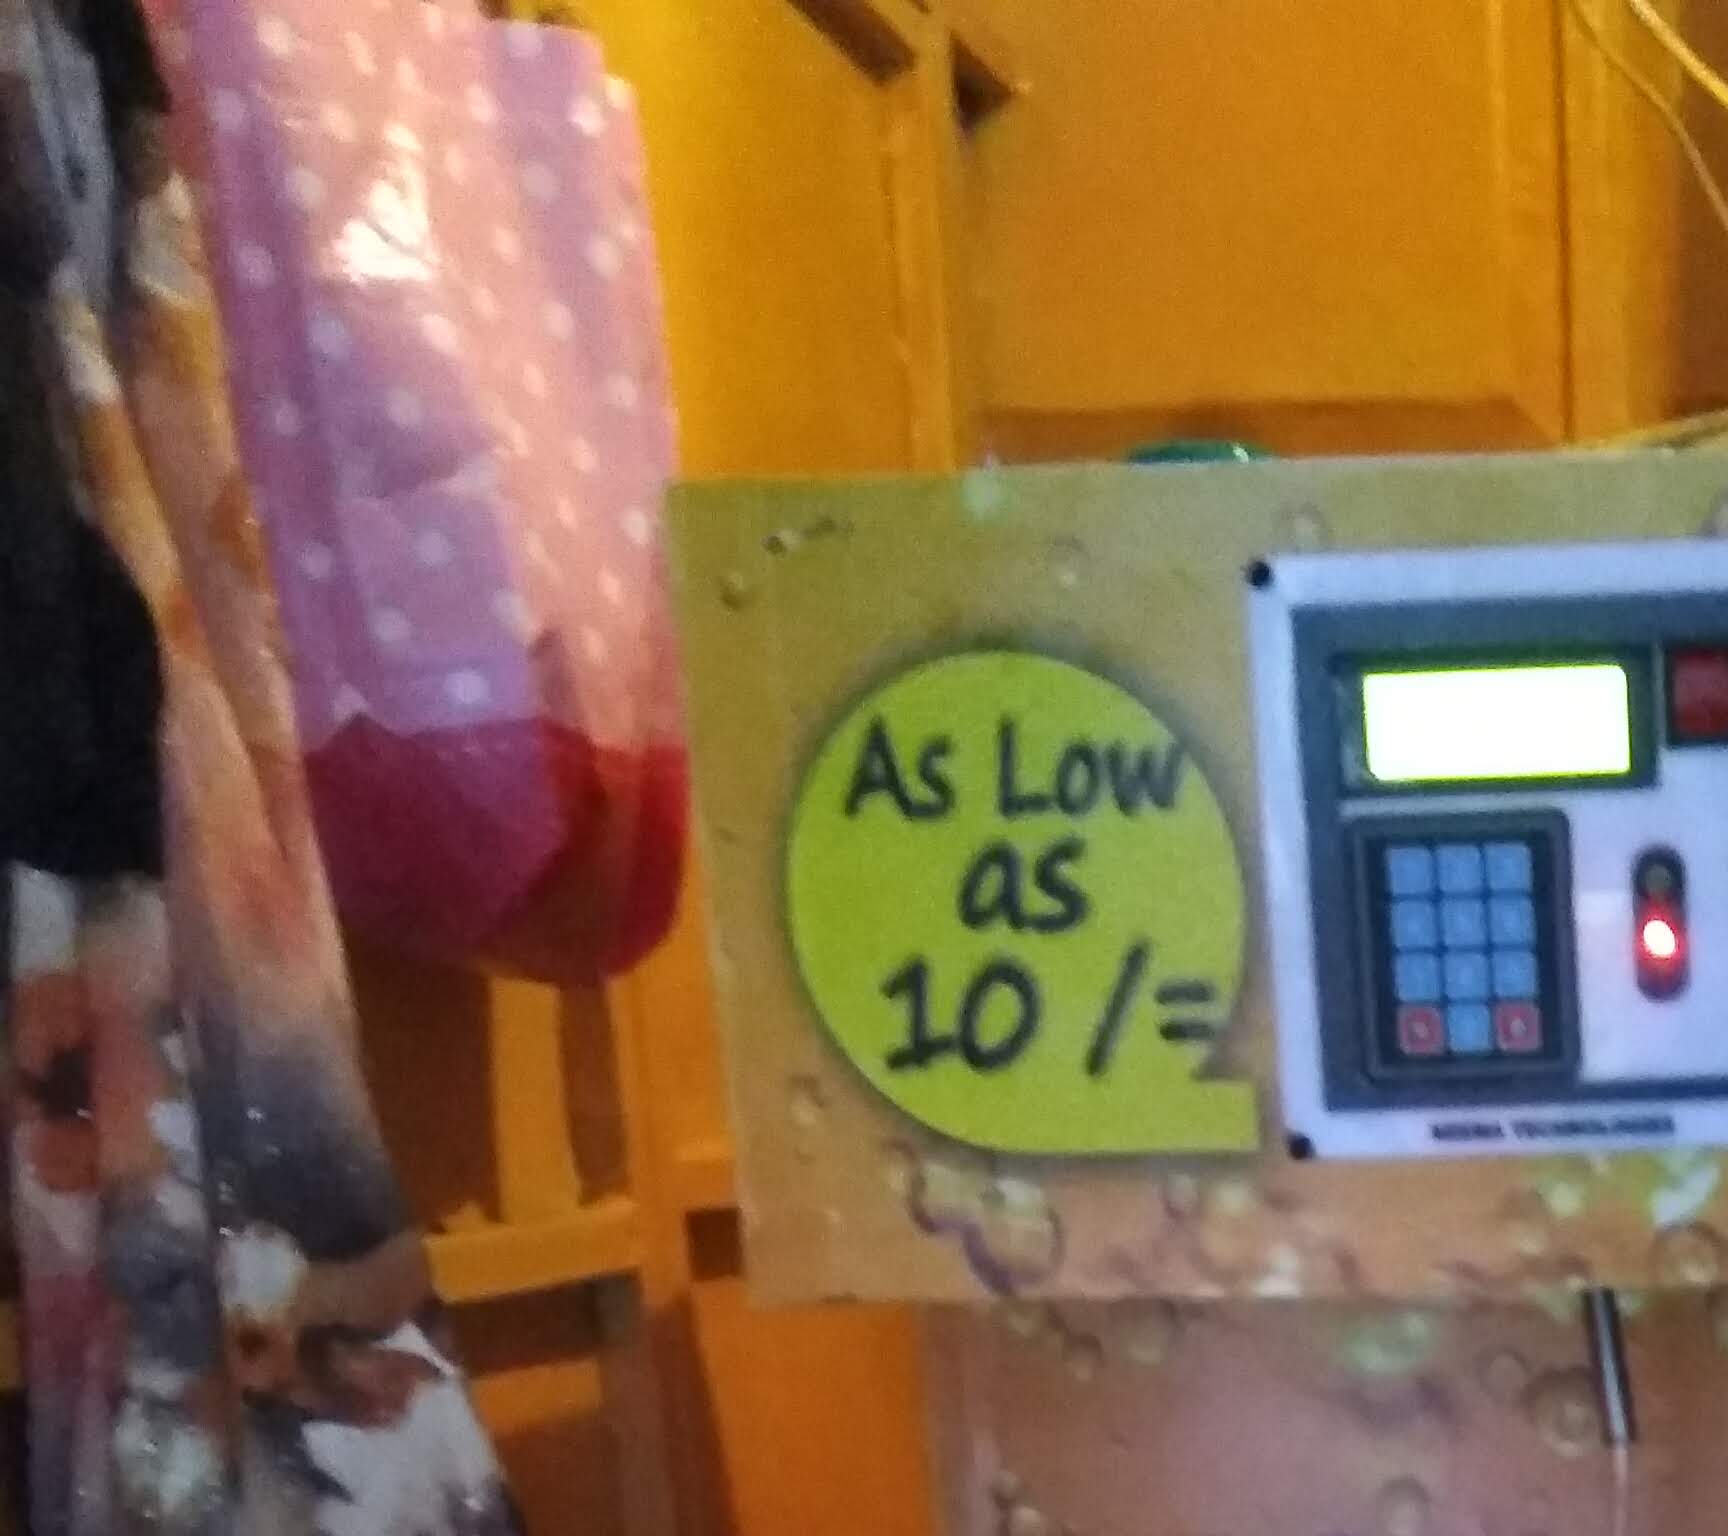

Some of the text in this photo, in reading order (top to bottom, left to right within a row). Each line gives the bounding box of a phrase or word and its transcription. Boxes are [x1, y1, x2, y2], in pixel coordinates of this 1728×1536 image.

[842, 712, 1184, 822] As Low
[957, 838, 1093, 934] as
